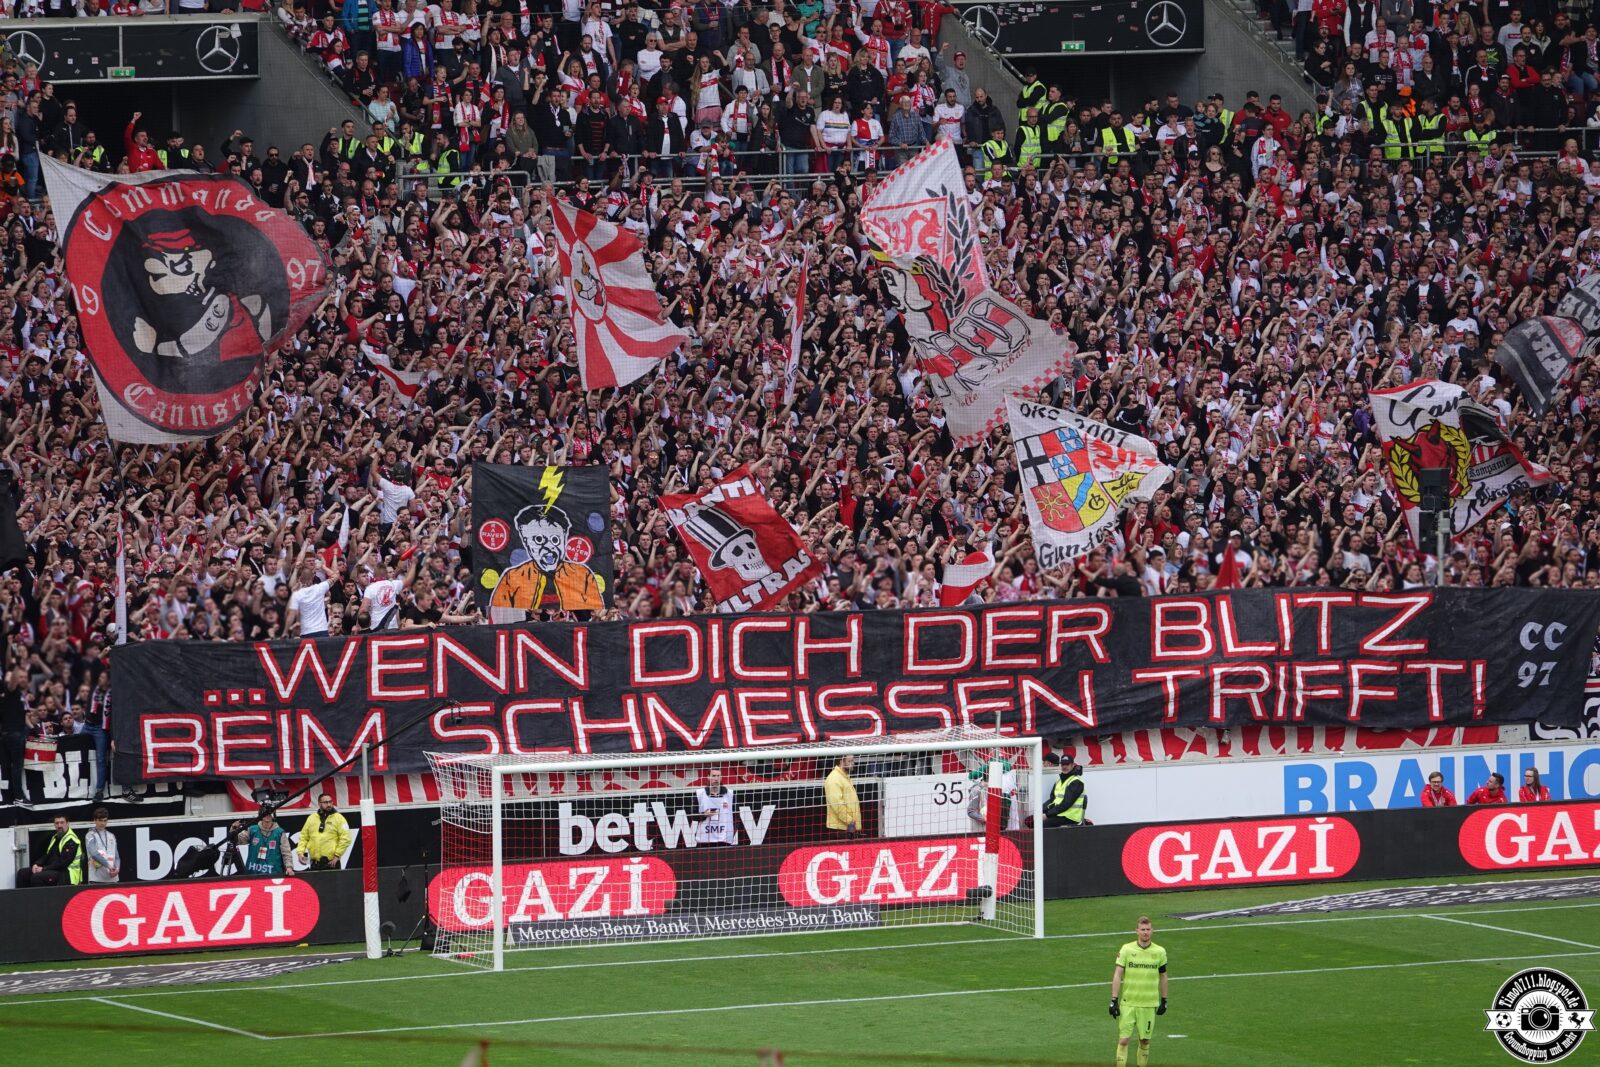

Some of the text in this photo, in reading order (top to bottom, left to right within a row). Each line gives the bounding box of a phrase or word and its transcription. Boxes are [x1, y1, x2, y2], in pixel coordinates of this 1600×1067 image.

[83, 182, 277, 241] Commando
[286, 257, 322, 290] 97
[70, 282, 100, 316] 19
[629, 614, 863, 687] DICH
[903, 603, 1112, 676] DER
[1151, 591, 1433, 662] BLITZ
[1520, 621, 1568, 651] CC
[1517, 661, 1558, 688] 97
[139, 706, 389, 779] BEIM
[428, 670, 1098, 767] SCHMEISSEN
[1131, 660, 1488, 722] TRIFFT!
[934, 781, 964, 806] 35
[558, 801, 776, 855] betwy
[705, 825, 725, 834] SMF
[249, 862, 274, 873] HOST
[519, 920, 691, 941] Mercedes-Benz Bank
[704, 908, 875, 932] Mercedes-Benz Bank
[1128, 961, 1158, 969] Barmenia
[1146, 1021, 1151, 1031] 1
